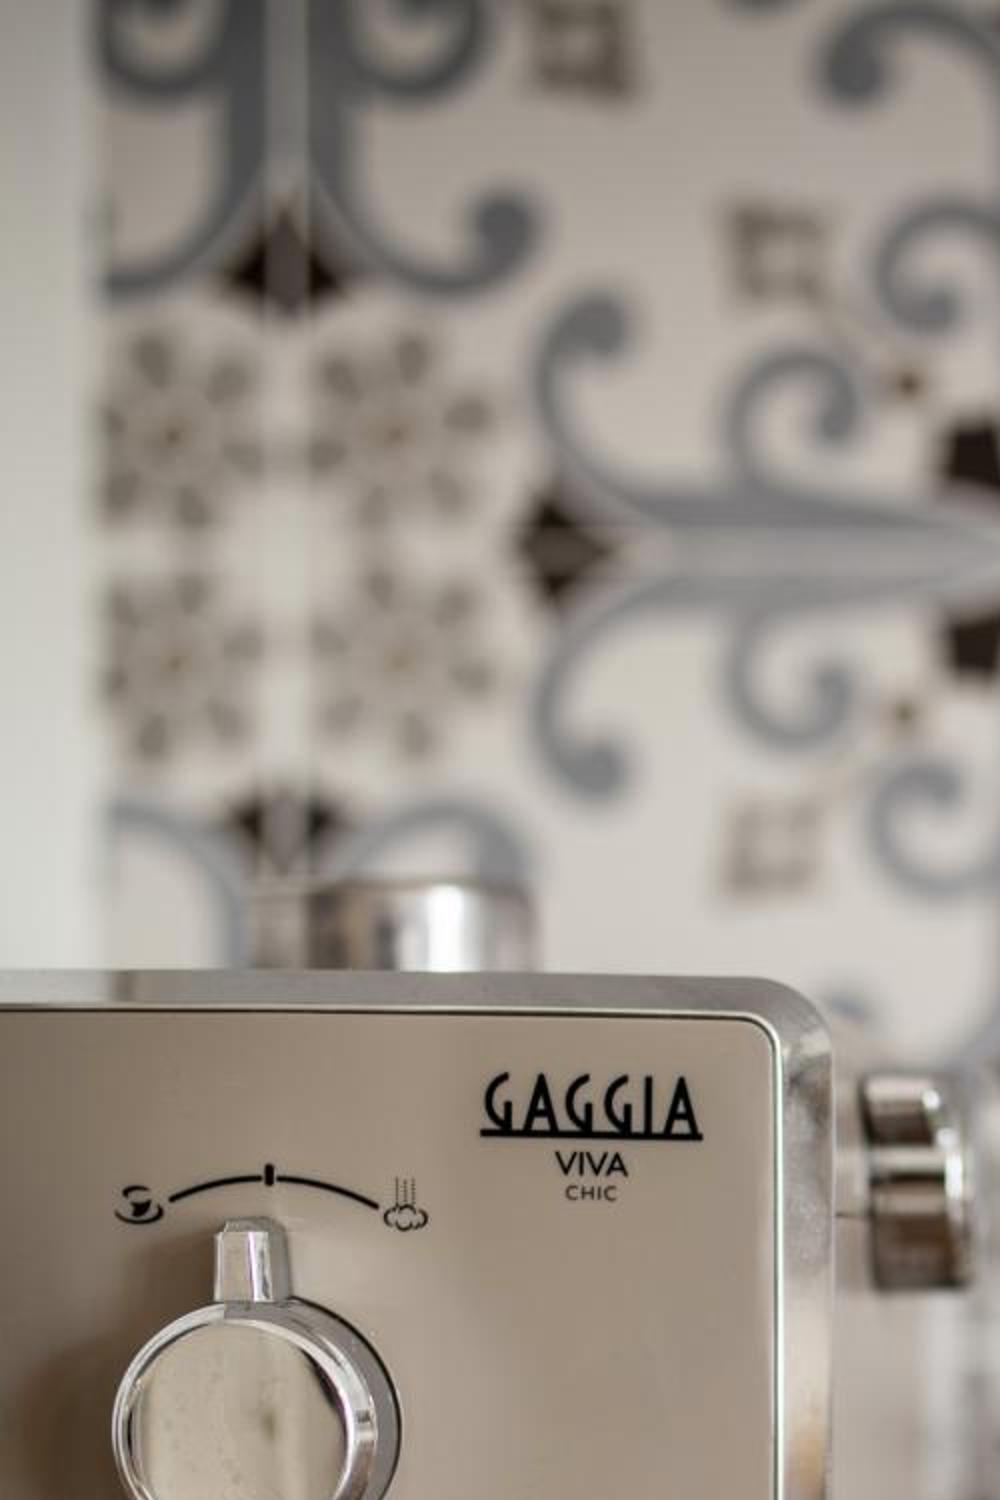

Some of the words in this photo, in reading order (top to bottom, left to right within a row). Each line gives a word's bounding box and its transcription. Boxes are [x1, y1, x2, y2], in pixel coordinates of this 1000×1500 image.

[482, 1071, 702, 1140] GAGGIA
[554, 1150, 629, 1177] VIVA
[564, 1184, 618, 1202] CHIC
